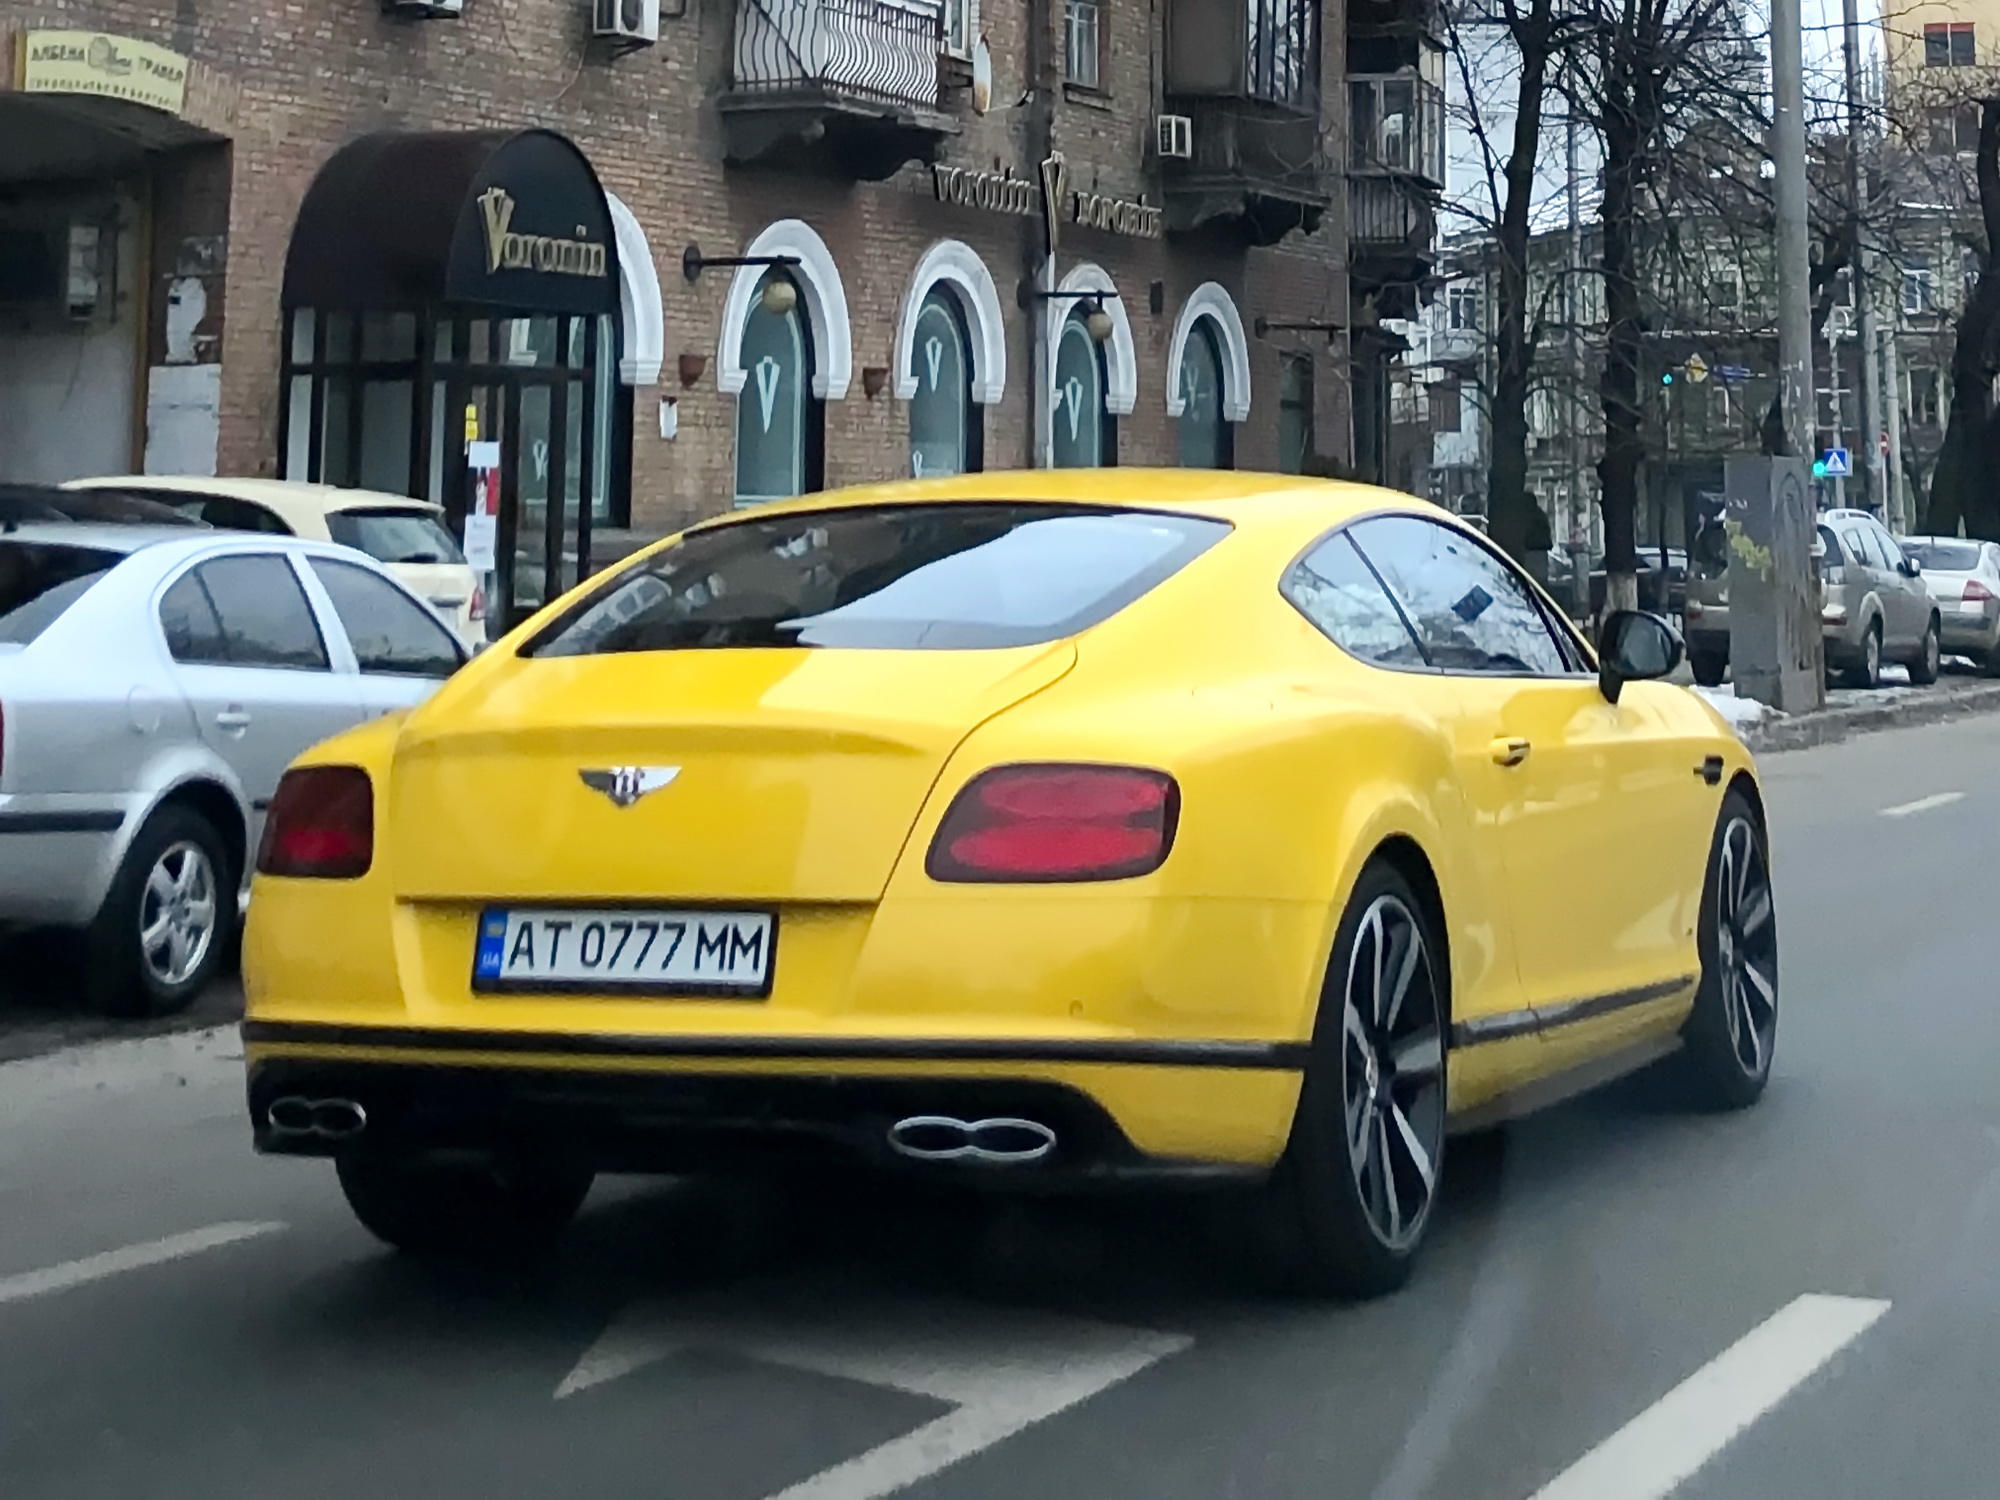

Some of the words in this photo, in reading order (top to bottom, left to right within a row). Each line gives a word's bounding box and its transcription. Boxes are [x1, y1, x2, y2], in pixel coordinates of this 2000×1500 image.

[477, 186, 606, 276] Voronin
[508, 920, 573, 969] AT
[579, 920, 687, 970] 0777
[694, 922, 764, 973] MM
